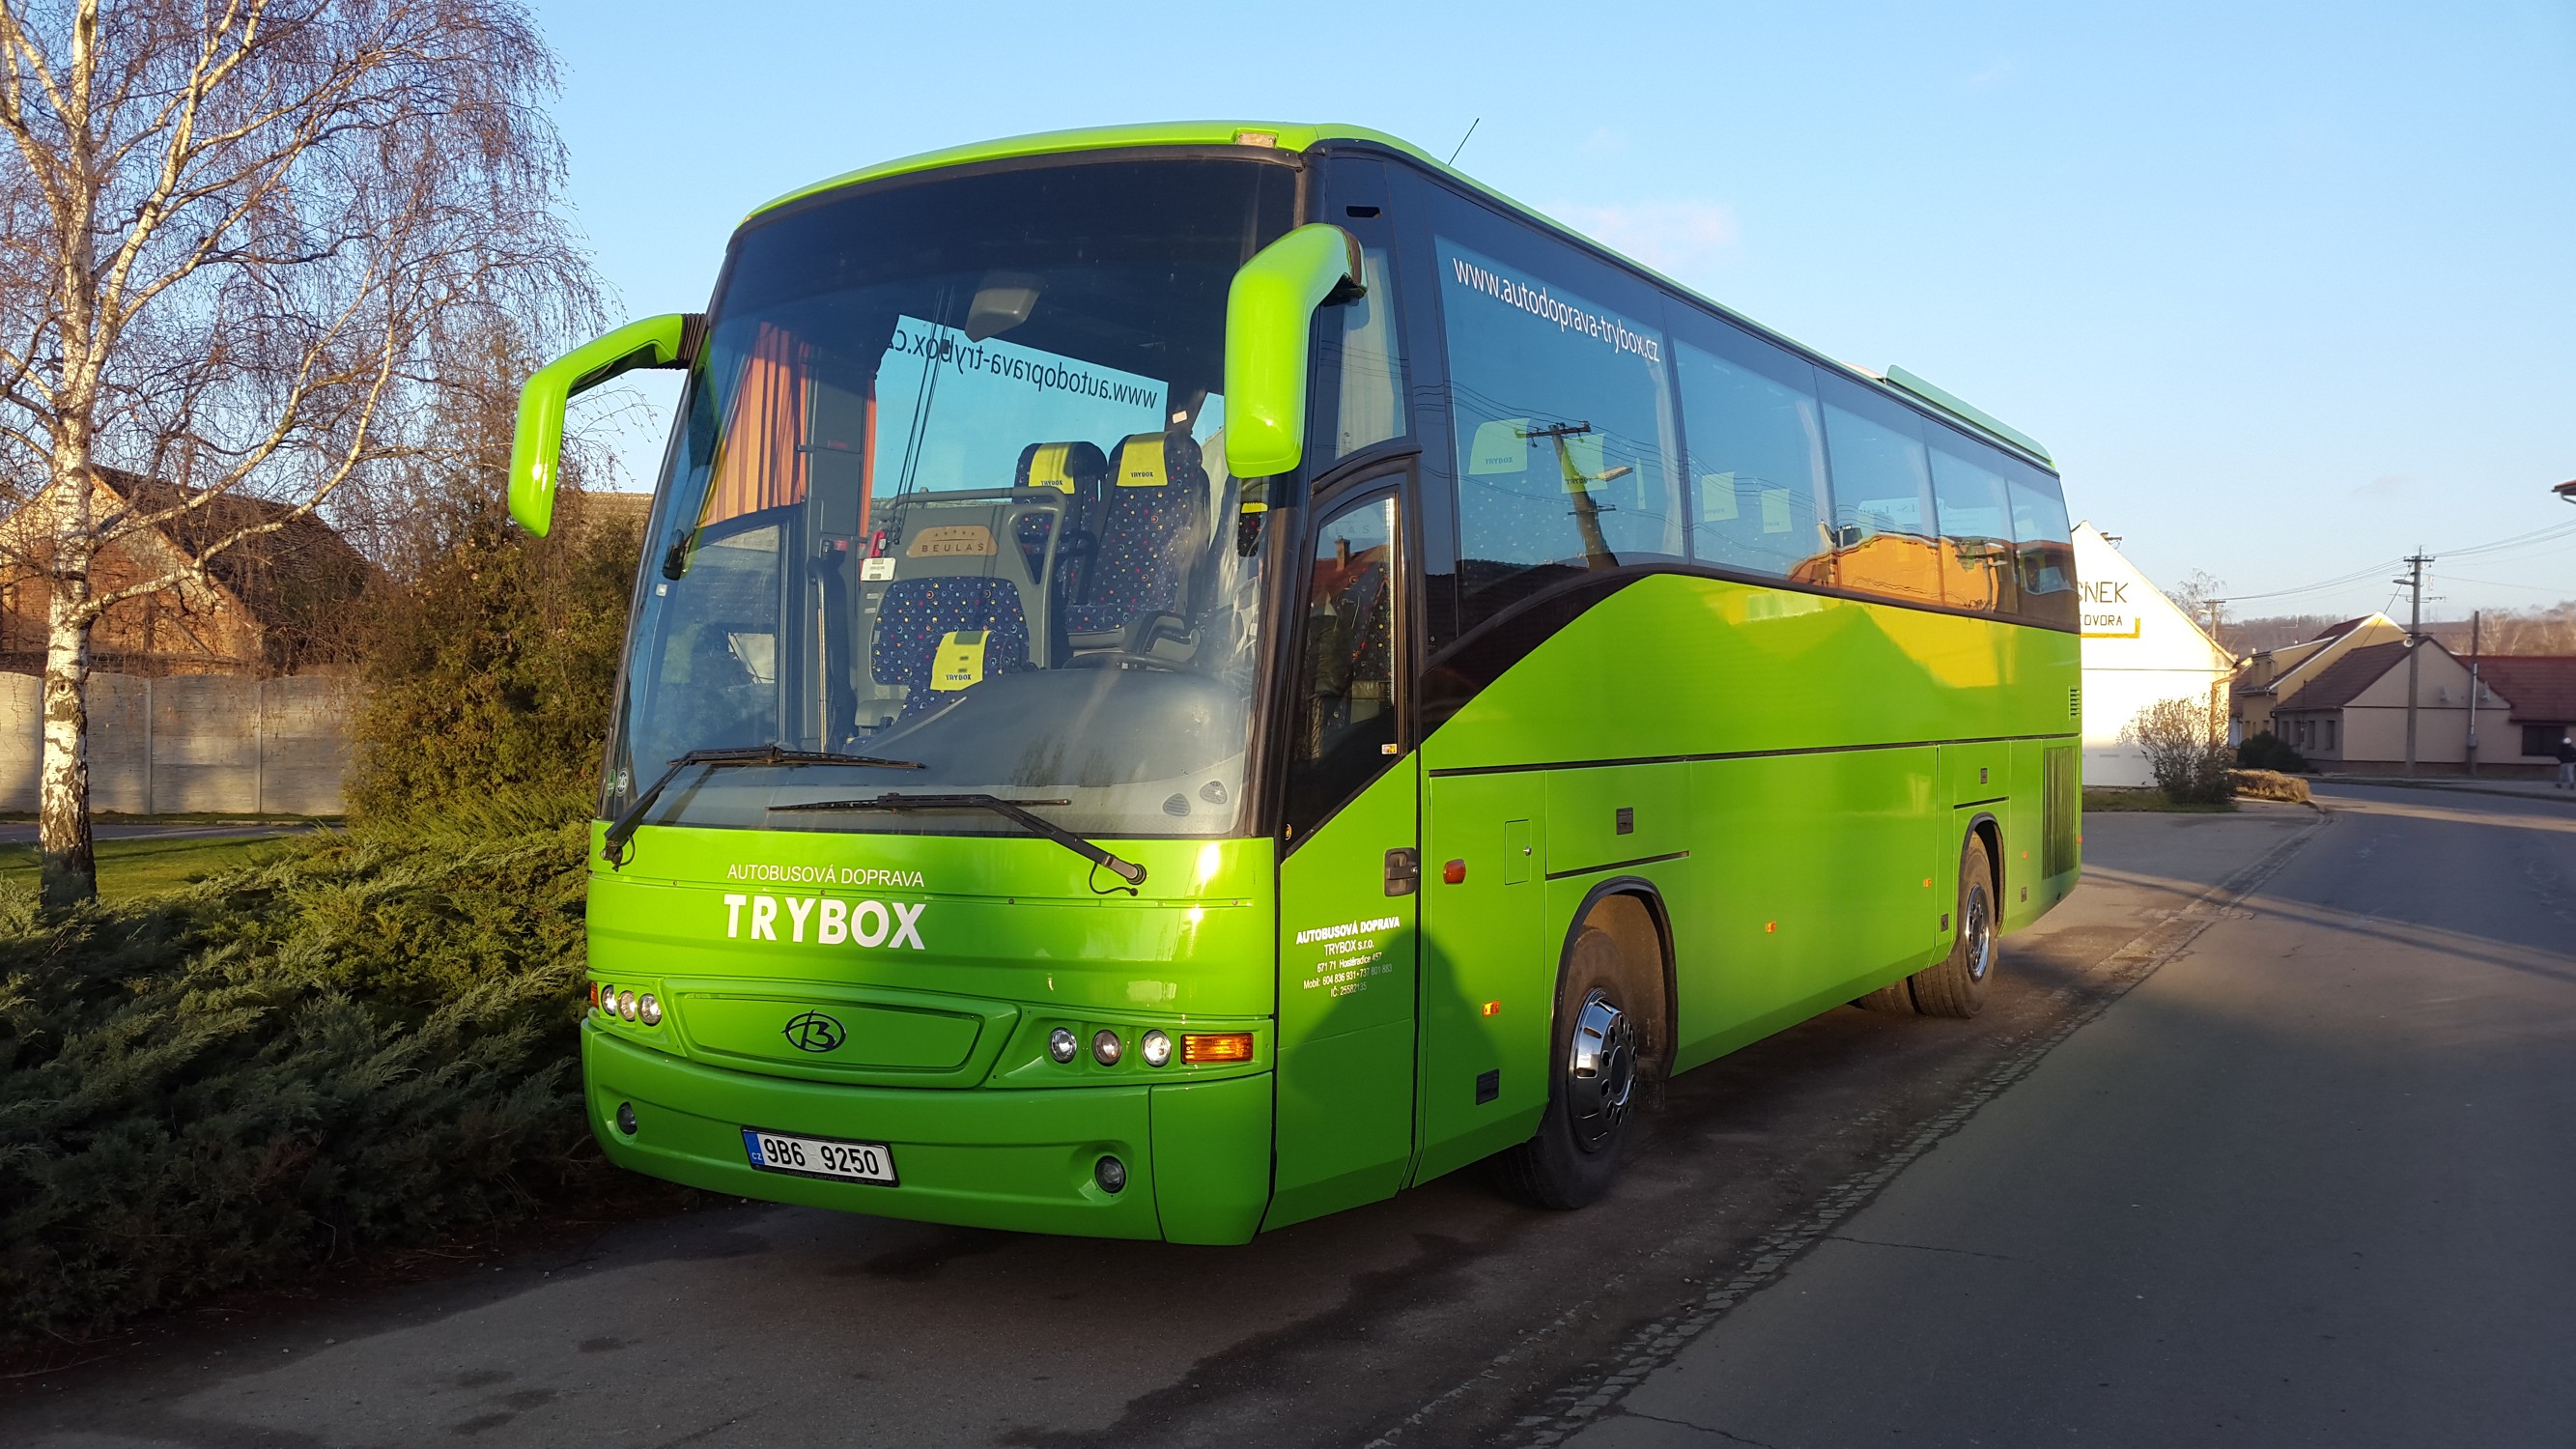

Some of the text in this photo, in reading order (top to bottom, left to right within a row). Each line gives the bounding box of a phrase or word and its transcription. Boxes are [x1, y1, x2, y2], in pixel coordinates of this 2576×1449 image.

[1452, 257, 1660, 362] www.autodoprava-trybox.cz
[921, 543, 984, 553] BEULAS
[727, 864, 925, 887] AUTOBUSOVÁ DOPRAVA
[723, 894, 926, 950] TRYBOX
[1295, 916, 1401, 945] AUTOBUSOVÁ DOPRAVA
[1324, 939, 1374, 956] TRYBOX s.r.o.
[1316, 962, 1328, 974] 671
[1329, 960, 1337, 971] 71
[763, 1138, 806, 1166] 9B6
[821, 1146, 879, 1175] 9250
